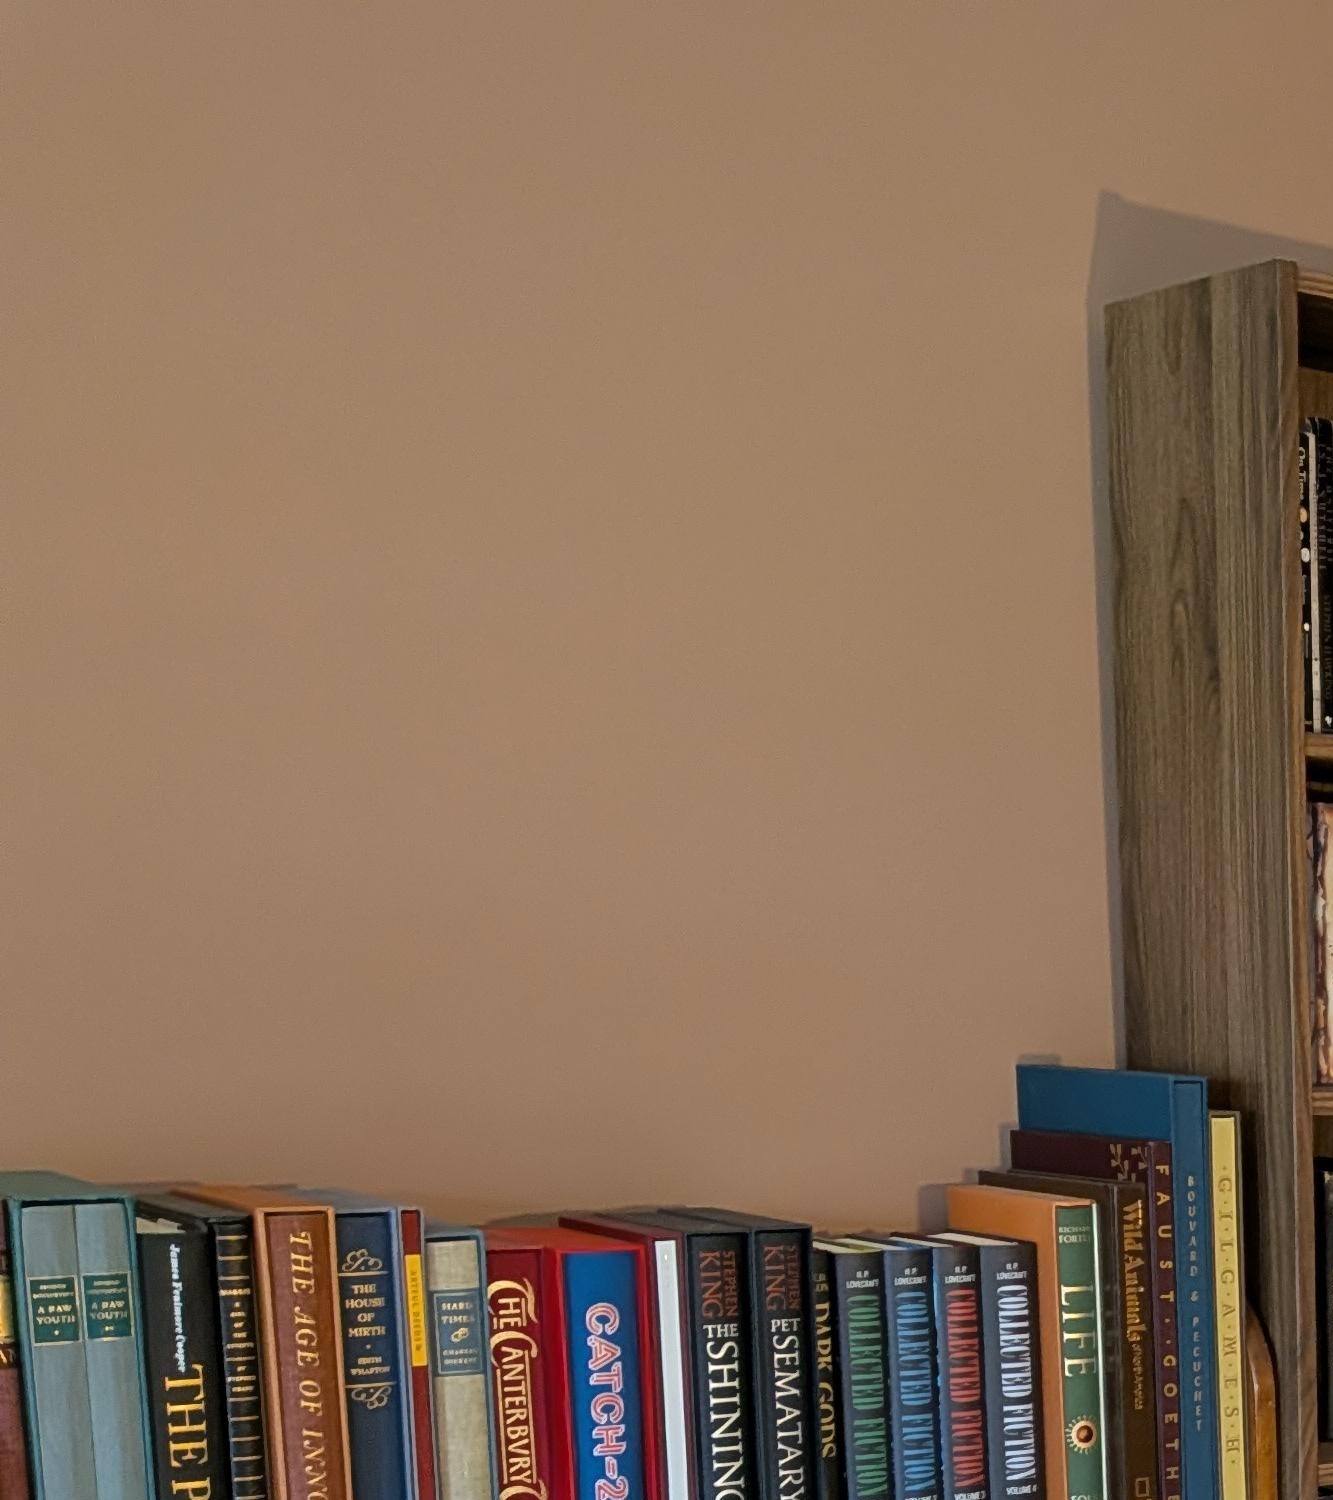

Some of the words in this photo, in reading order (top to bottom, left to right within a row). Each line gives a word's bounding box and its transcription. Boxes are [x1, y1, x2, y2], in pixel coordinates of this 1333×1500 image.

[1121, 1201, 1143, 1251] Wild
[1155, 1164, 1174, 1304] FAUST
[289, 1231, 316, 1294] THE
[351, 1285, 375, 1294] THE
[700, 1250, 724, 1319] KING
[723, 1251, 738, 1317] STEPHEN
[345, 1297, 385, 1308] HOUSE
[355, 1313, 374, 1322] OF
[486, 1278, 538, 1329] THE
[770, 1319, 801, 1333] PET
[1123, 1255, 1147, 1342] Animals
[173, 1335, 189, 1372] Cooper
[294, 1306, 321, 1367] AGE
[349, 1327, 386, 1337] MIRTH
[703, 1324, 739, 1340] THE
[996, 1284, 1033, 1398] COLLECTED
[1060, 1284, 1096, 1377] LIFE
[164, 1364, 208, 1467] THE
[299, 1379, 323, 1417] OF
[1002, 1404, 1036, 1481] FICTION
